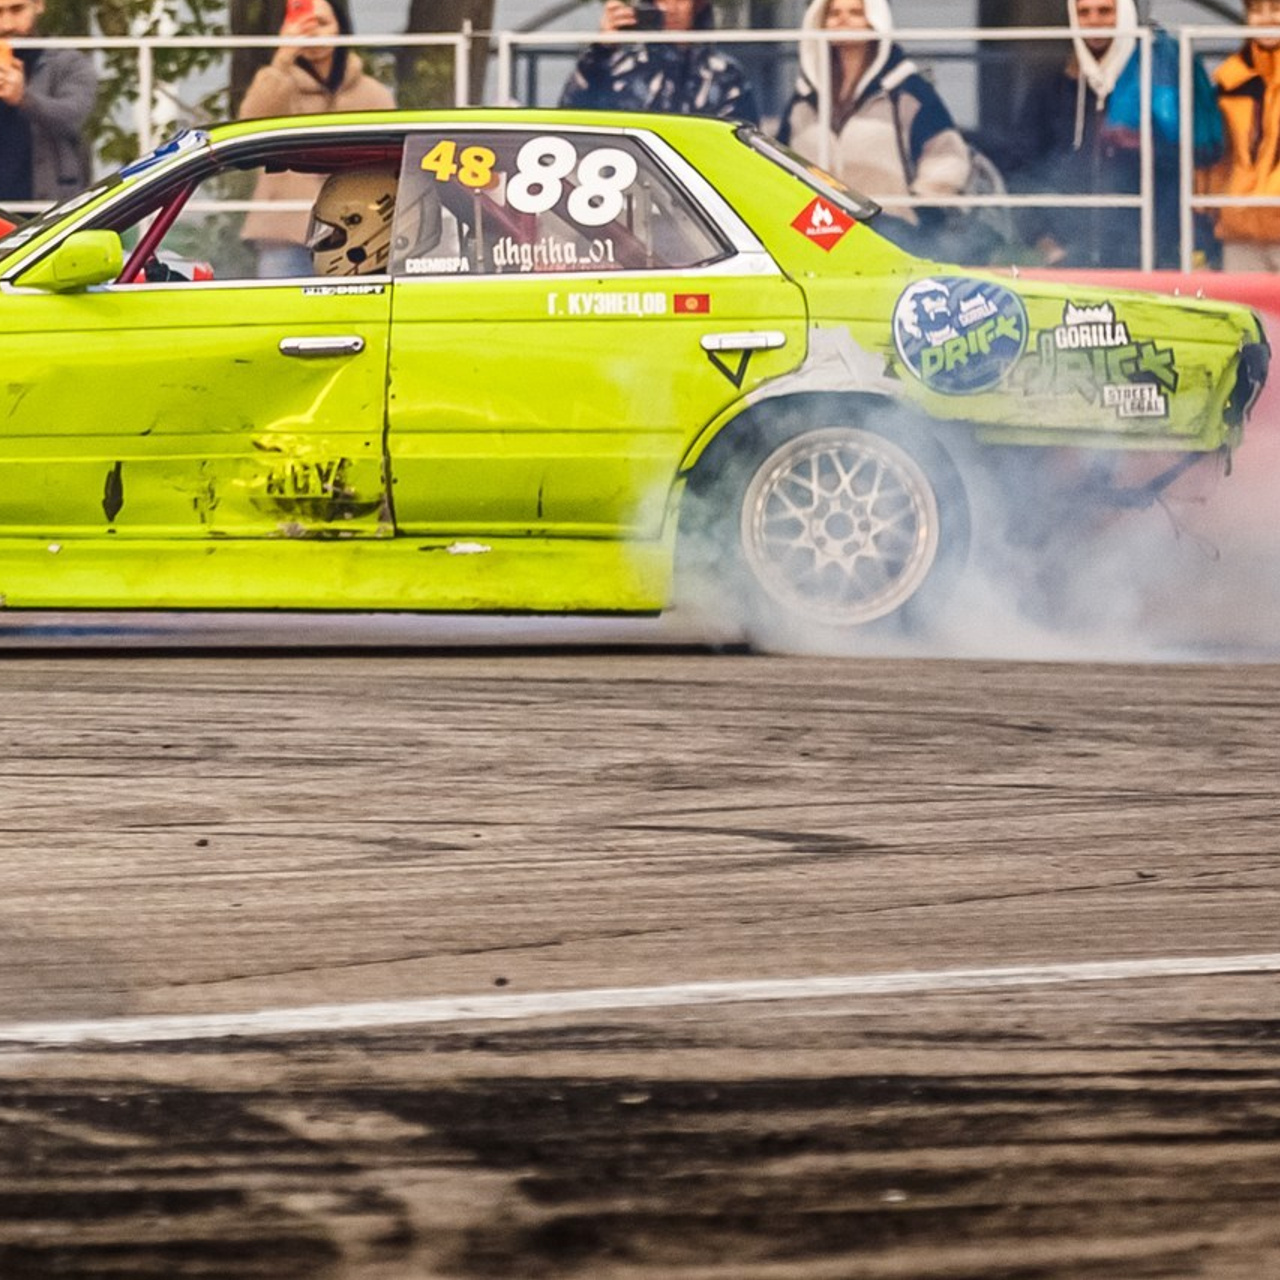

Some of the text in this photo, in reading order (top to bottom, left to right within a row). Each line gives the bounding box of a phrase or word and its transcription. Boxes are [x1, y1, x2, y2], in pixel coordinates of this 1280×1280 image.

[421, 140, 496, 188] 48
[507, 136, 637, 226] 88
[568, 292, 667, 318] КУЗНЕЦОВ
[1055, 322, 1128, 350] GORILLA
